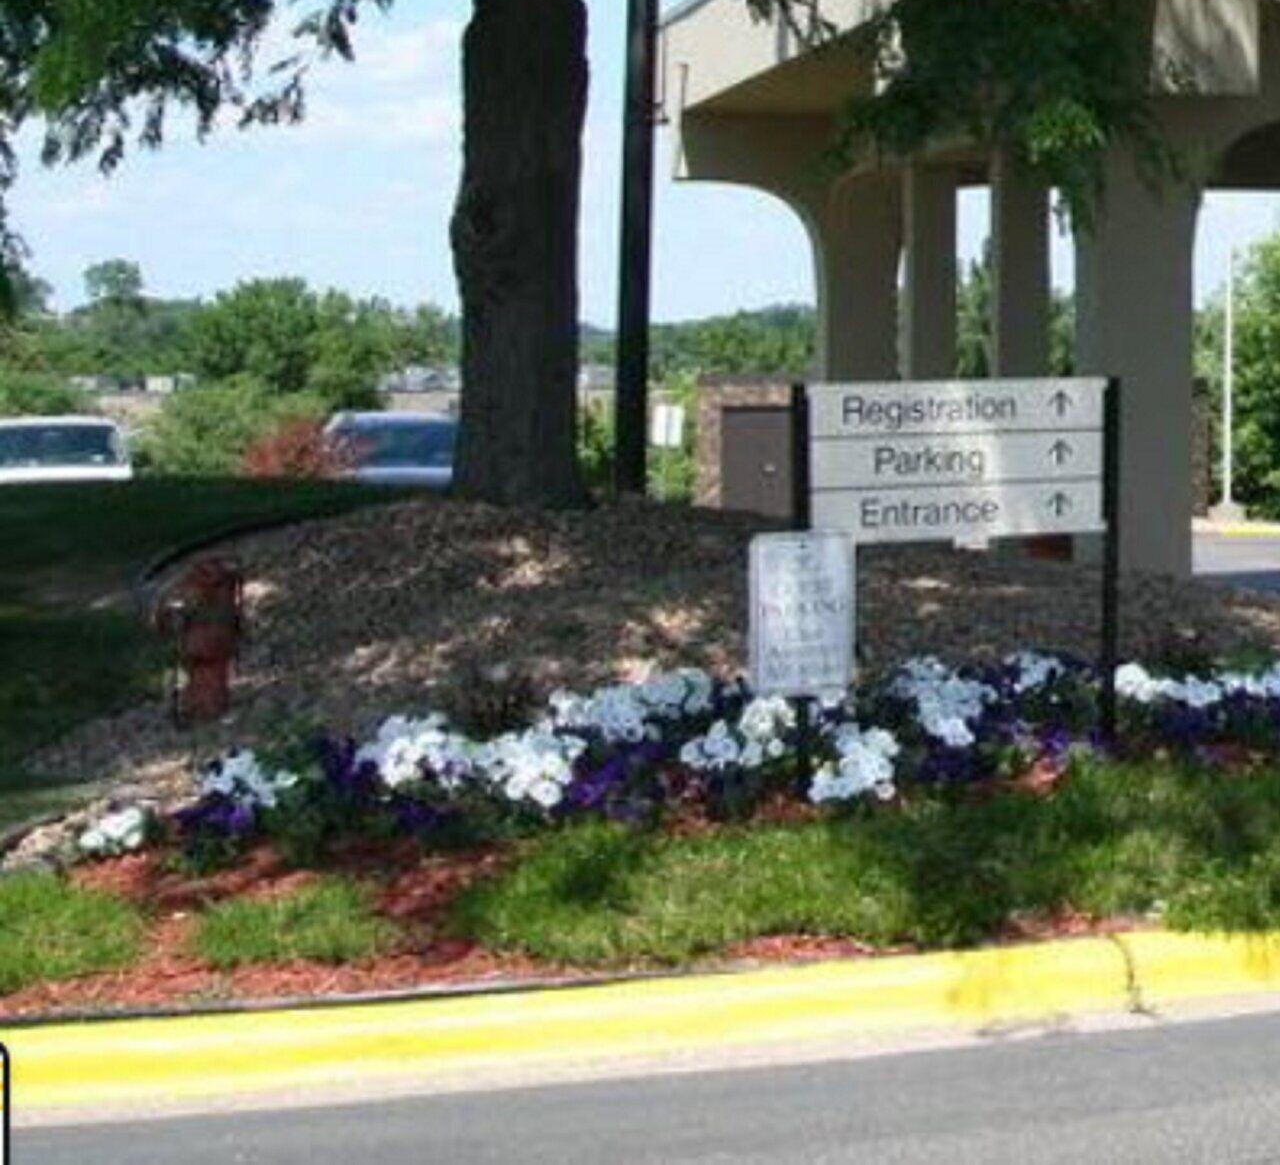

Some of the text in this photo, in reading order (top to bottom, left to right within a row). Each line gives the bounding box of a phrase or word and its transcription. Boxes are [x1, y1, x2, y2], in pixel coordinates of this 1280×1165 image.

[841, 394, 1016, 429] Registration
[873, 445, 984, 476] Parking
[859, 498, 999, 528] Entrance
